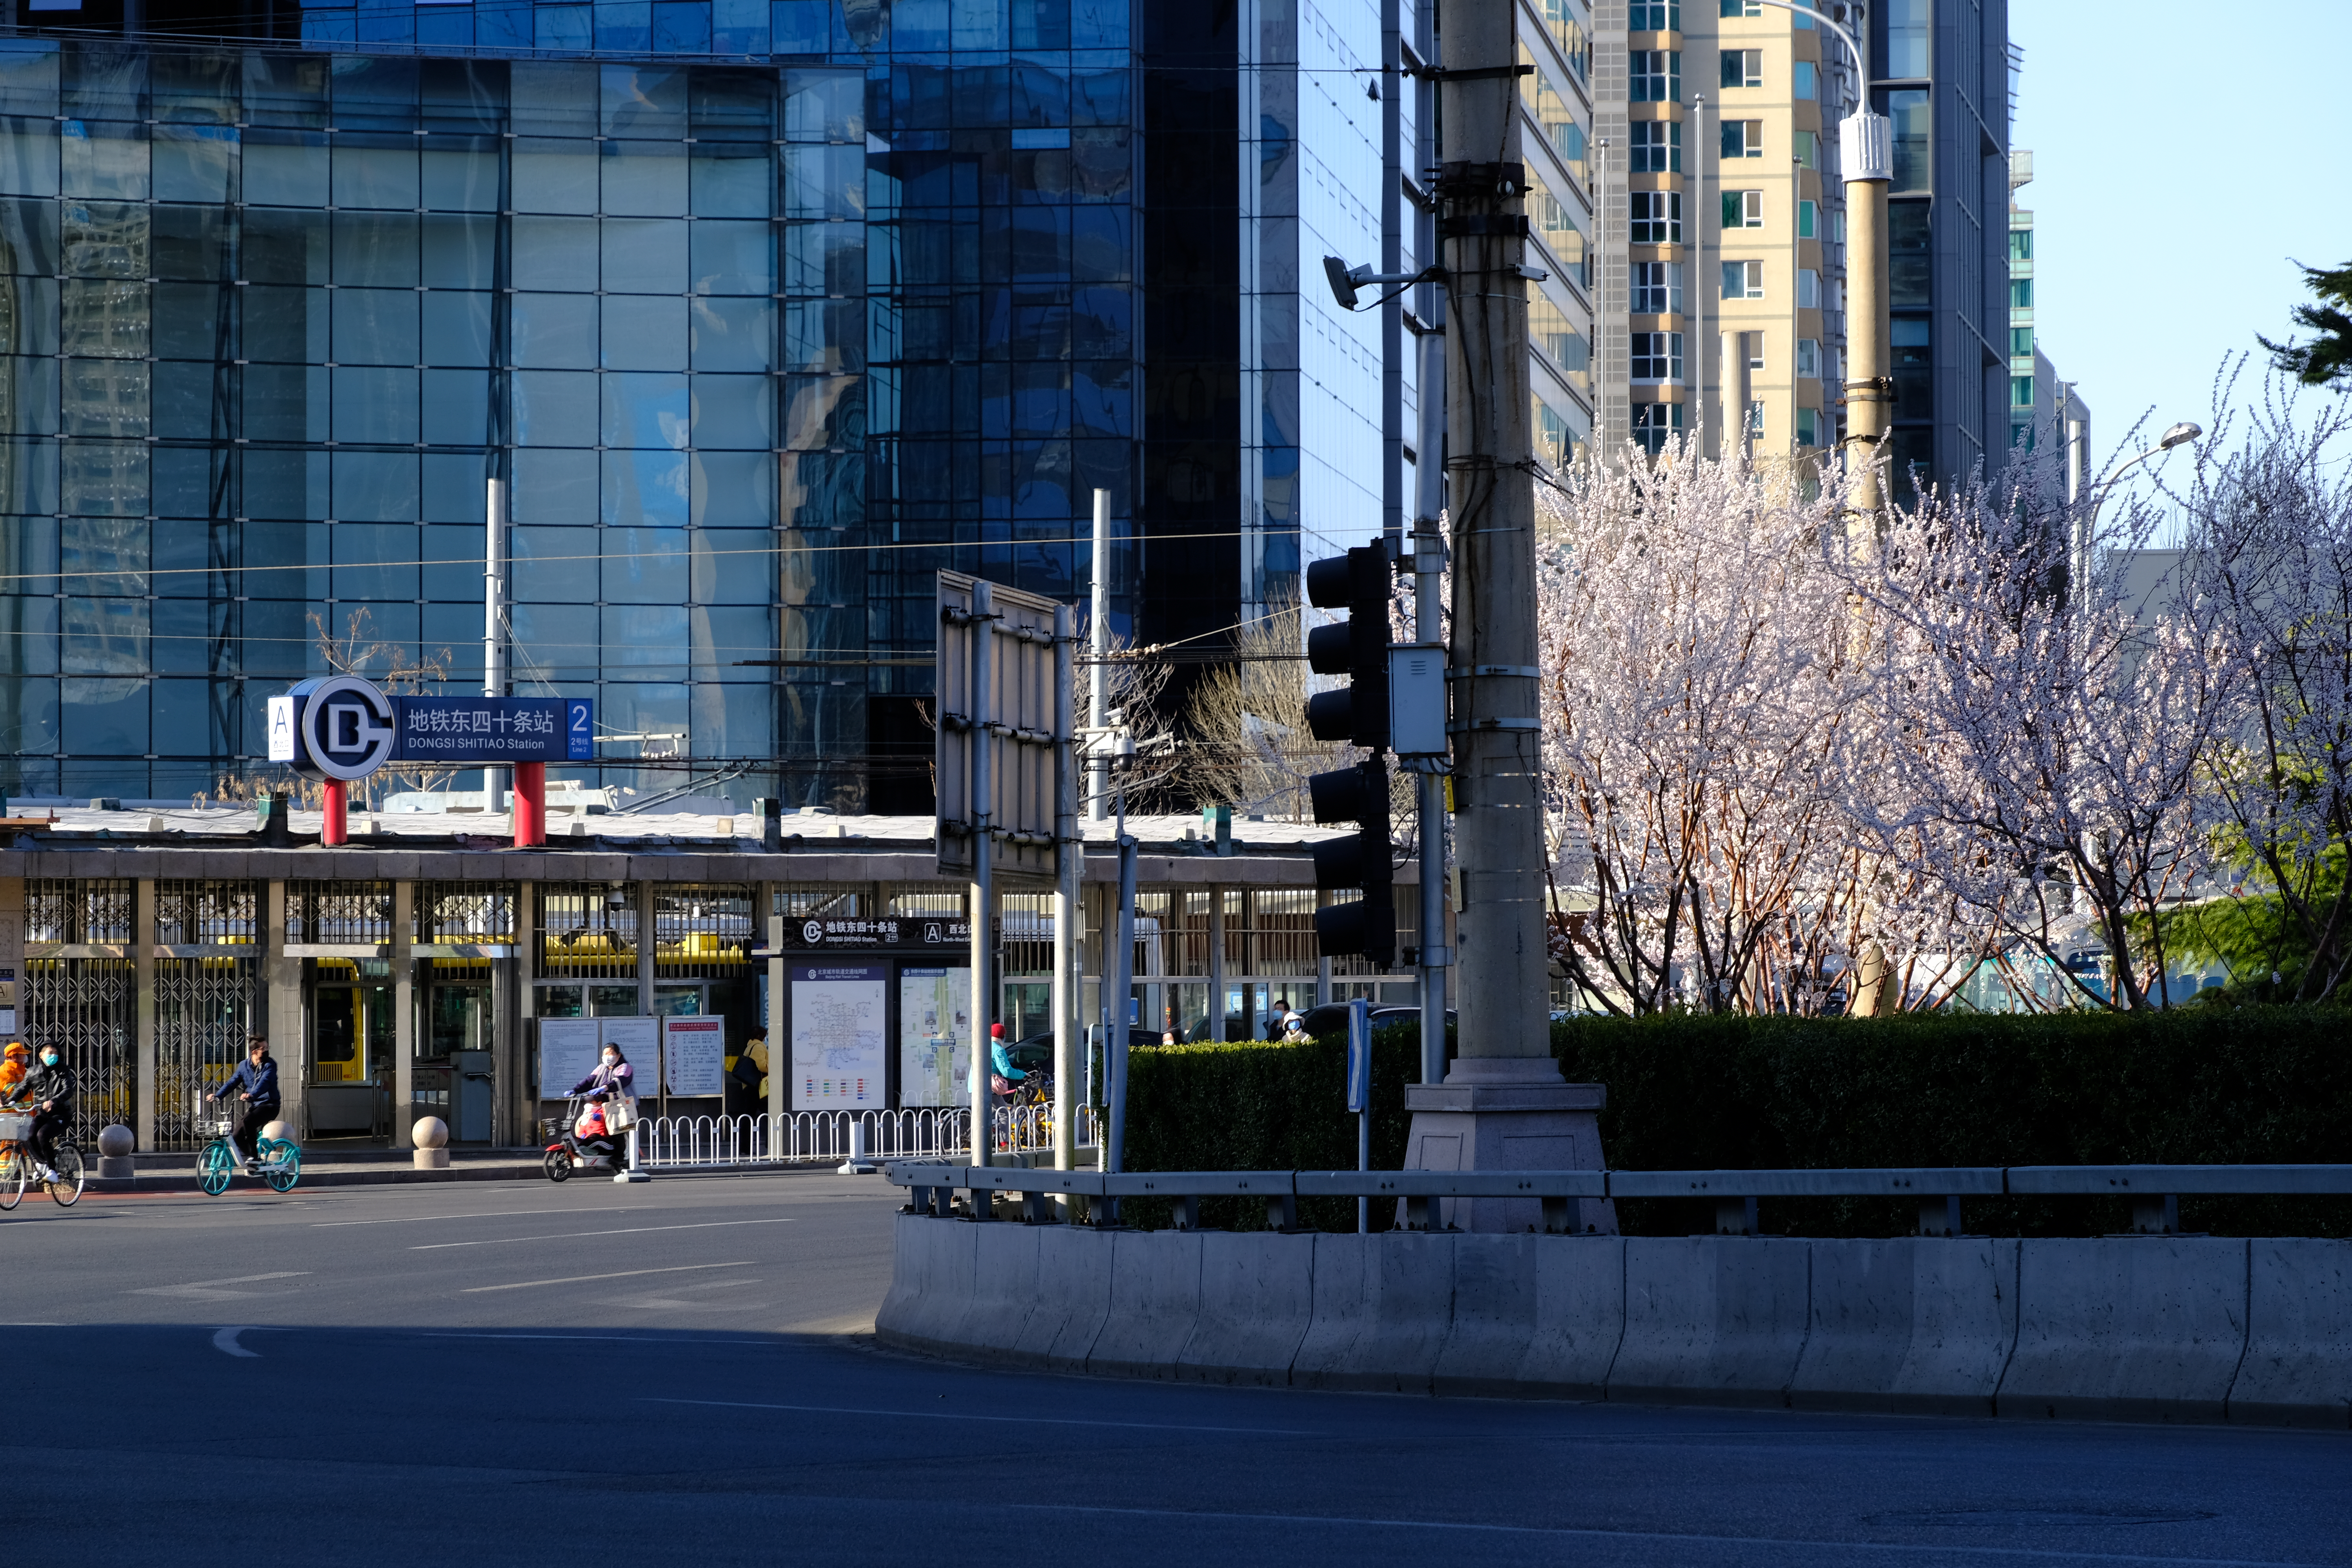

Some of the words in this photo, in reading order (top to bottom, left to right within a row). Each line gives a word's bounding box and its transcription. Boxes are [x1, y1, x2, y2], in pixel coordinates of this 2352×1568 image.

[274, 705, 288, 734] A
[408, 708, 554, 733] 地铁东四十条站
[572, 705, 587, 731] 2
[274, 740, 289, 748] 西北口
[408, 737, 455, 748] DONGSI
[457, 738, 505, 749] SHITIAO
[507, 738, 544, 749] Station
[570, 737, 588, 746] 2号线
[826, 921, 898, 933] 地铁东四十条站
[927, 925, 938, 940] A
